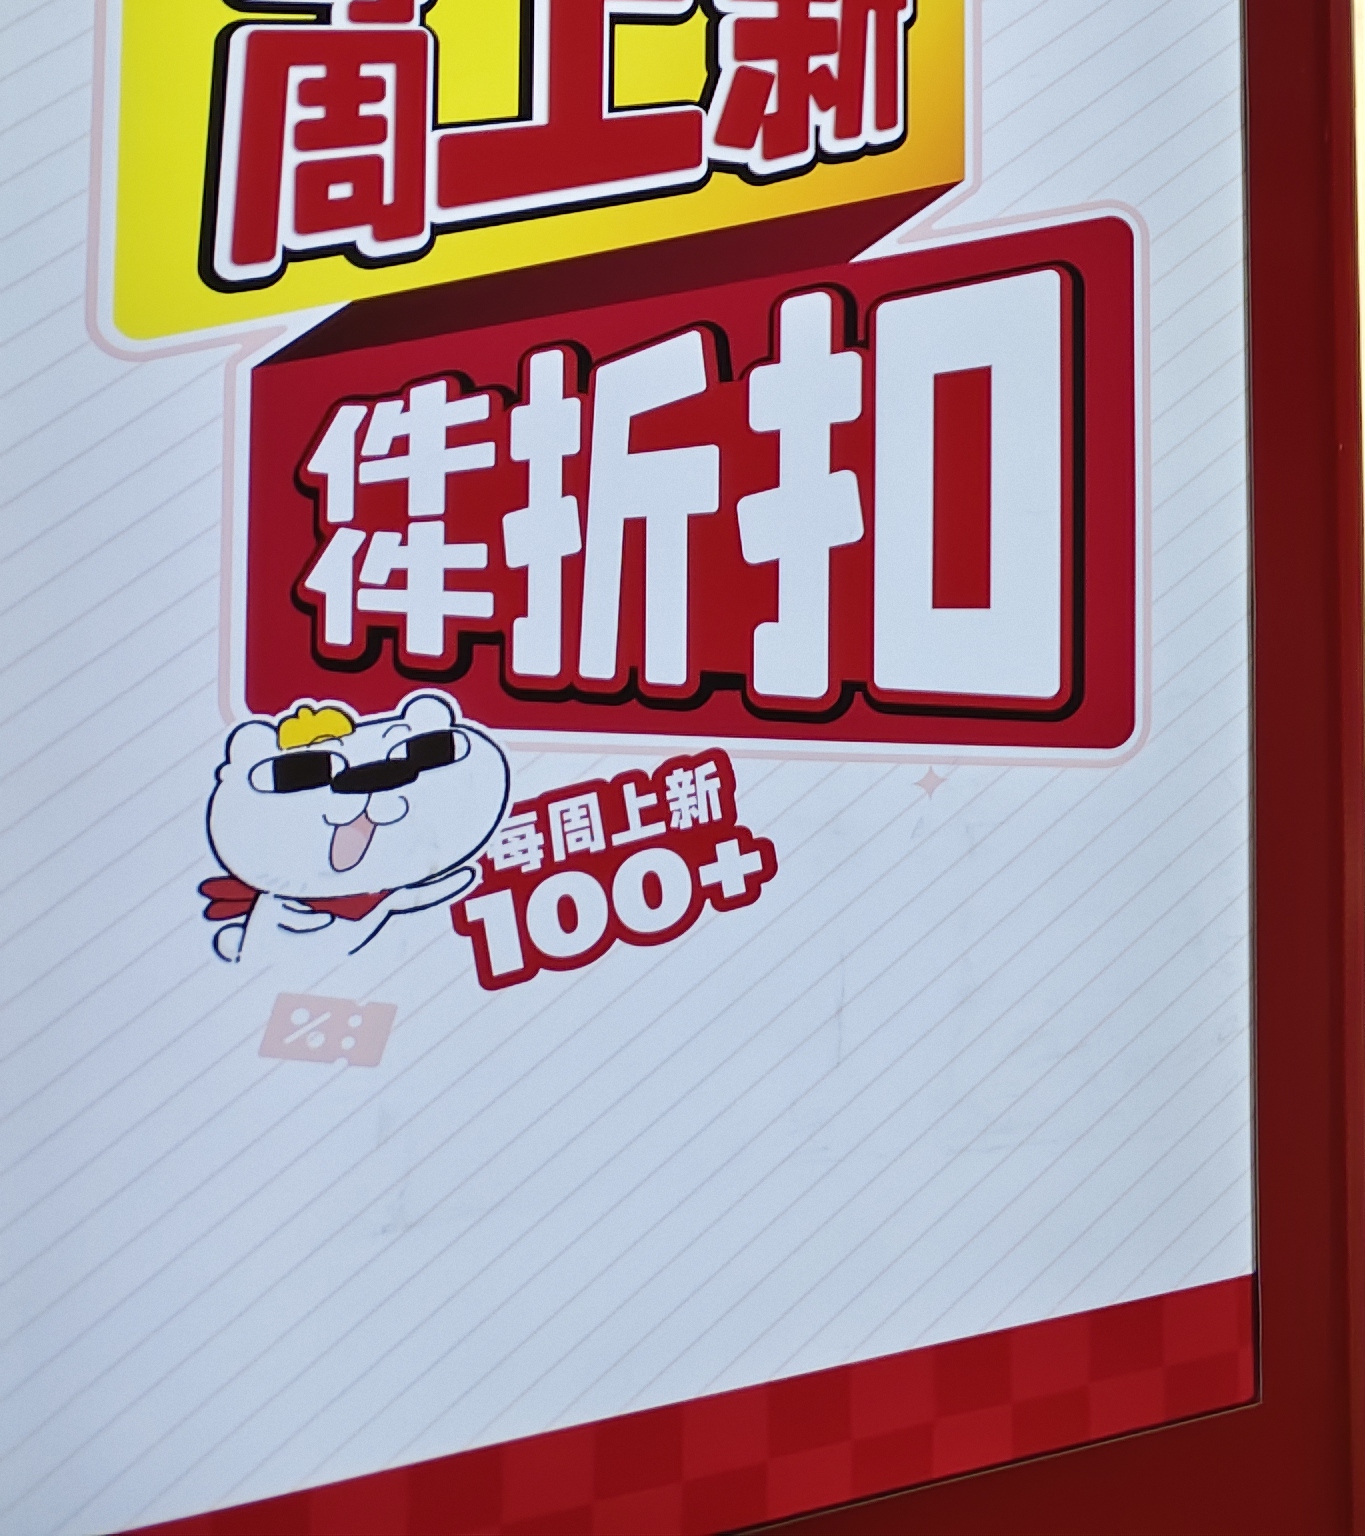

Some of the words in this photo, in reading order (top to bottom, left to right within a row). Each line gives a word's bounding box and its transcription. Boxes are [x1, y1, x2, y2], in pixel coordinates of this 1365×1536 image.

[306, 267, 1066, 698] 件件折扣
[484, 764, 724, 876] 每周上新
[465, 841, 766, 976] 100+
